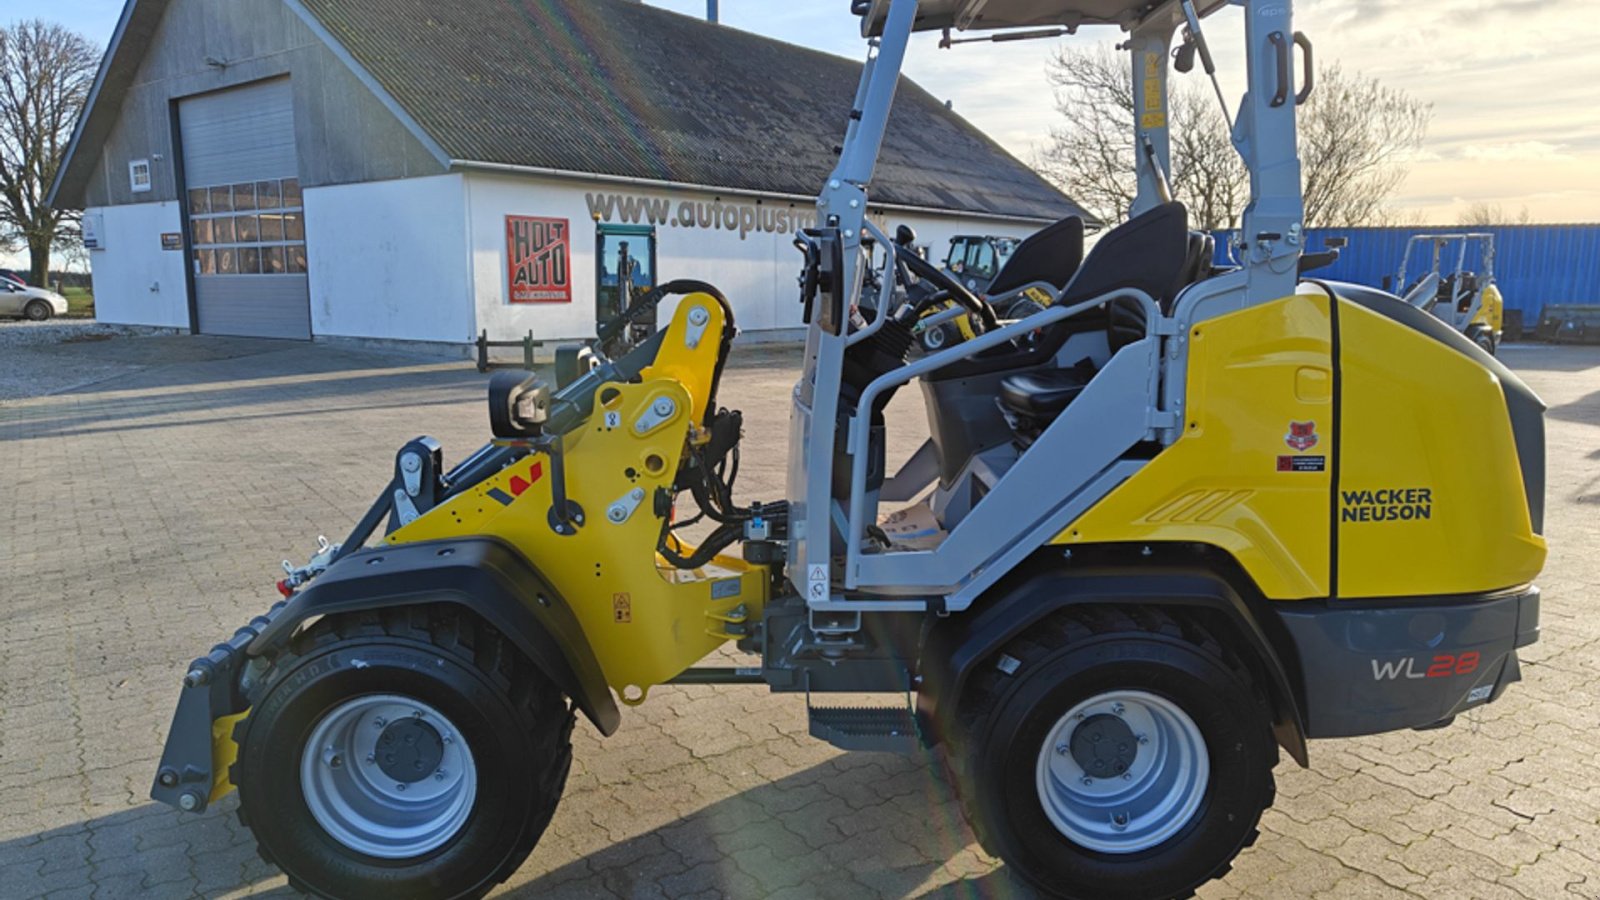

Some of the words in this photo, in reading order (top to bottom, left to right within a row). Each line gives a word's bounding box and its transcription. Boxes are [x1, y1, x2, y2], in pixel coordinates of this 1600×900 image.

[514, 219, 564, 264] HOLT
[514, 243, 566, 286] AUTO
[1341, 488, 1432, 505] WACKER
[1342, 505, 1431, 522] NEUSON
[1371, 652, 1480, 680] WL28
